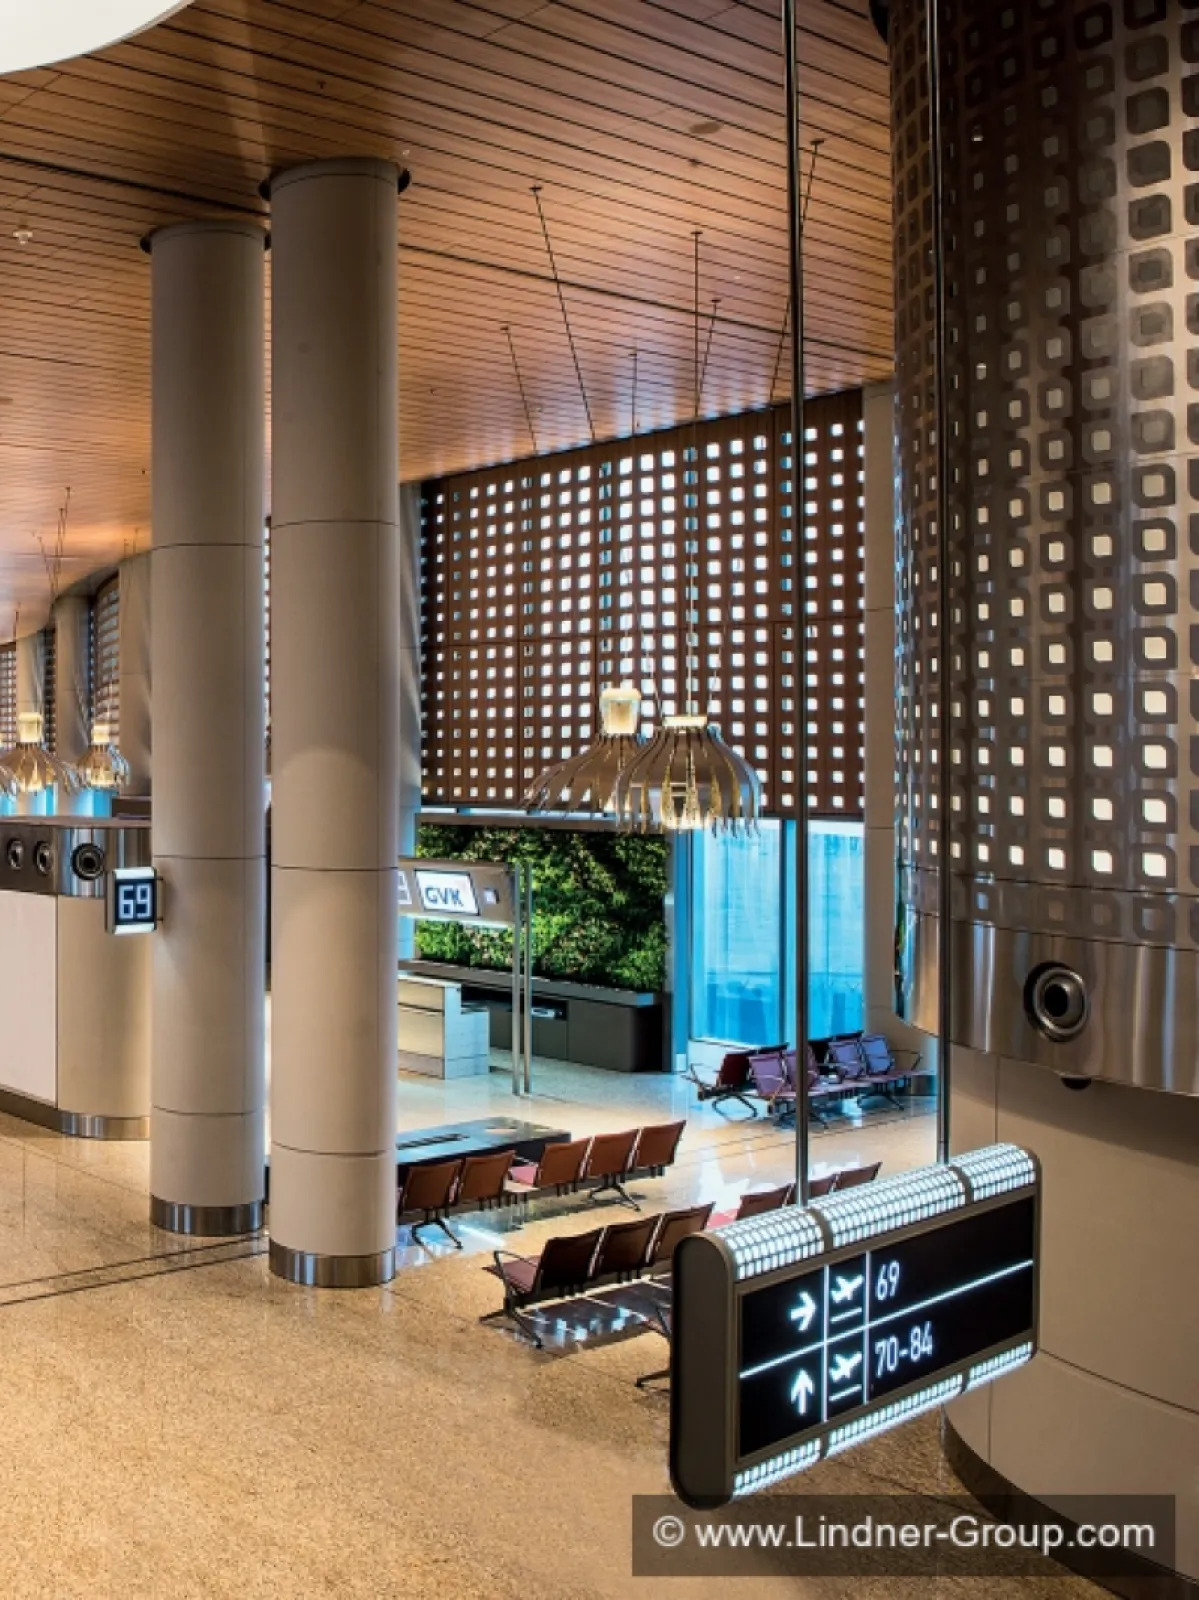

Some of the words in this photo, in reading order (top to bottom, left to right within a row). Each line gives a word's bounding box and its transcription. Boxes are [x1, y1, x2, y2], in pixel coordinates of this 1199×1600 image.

[119, 883, 152, 919] 69
[425, 887, 464, 906] GVK
[876, 1260, 900, 1301] 69
[874, 1320, 933, 1378] 70-84
